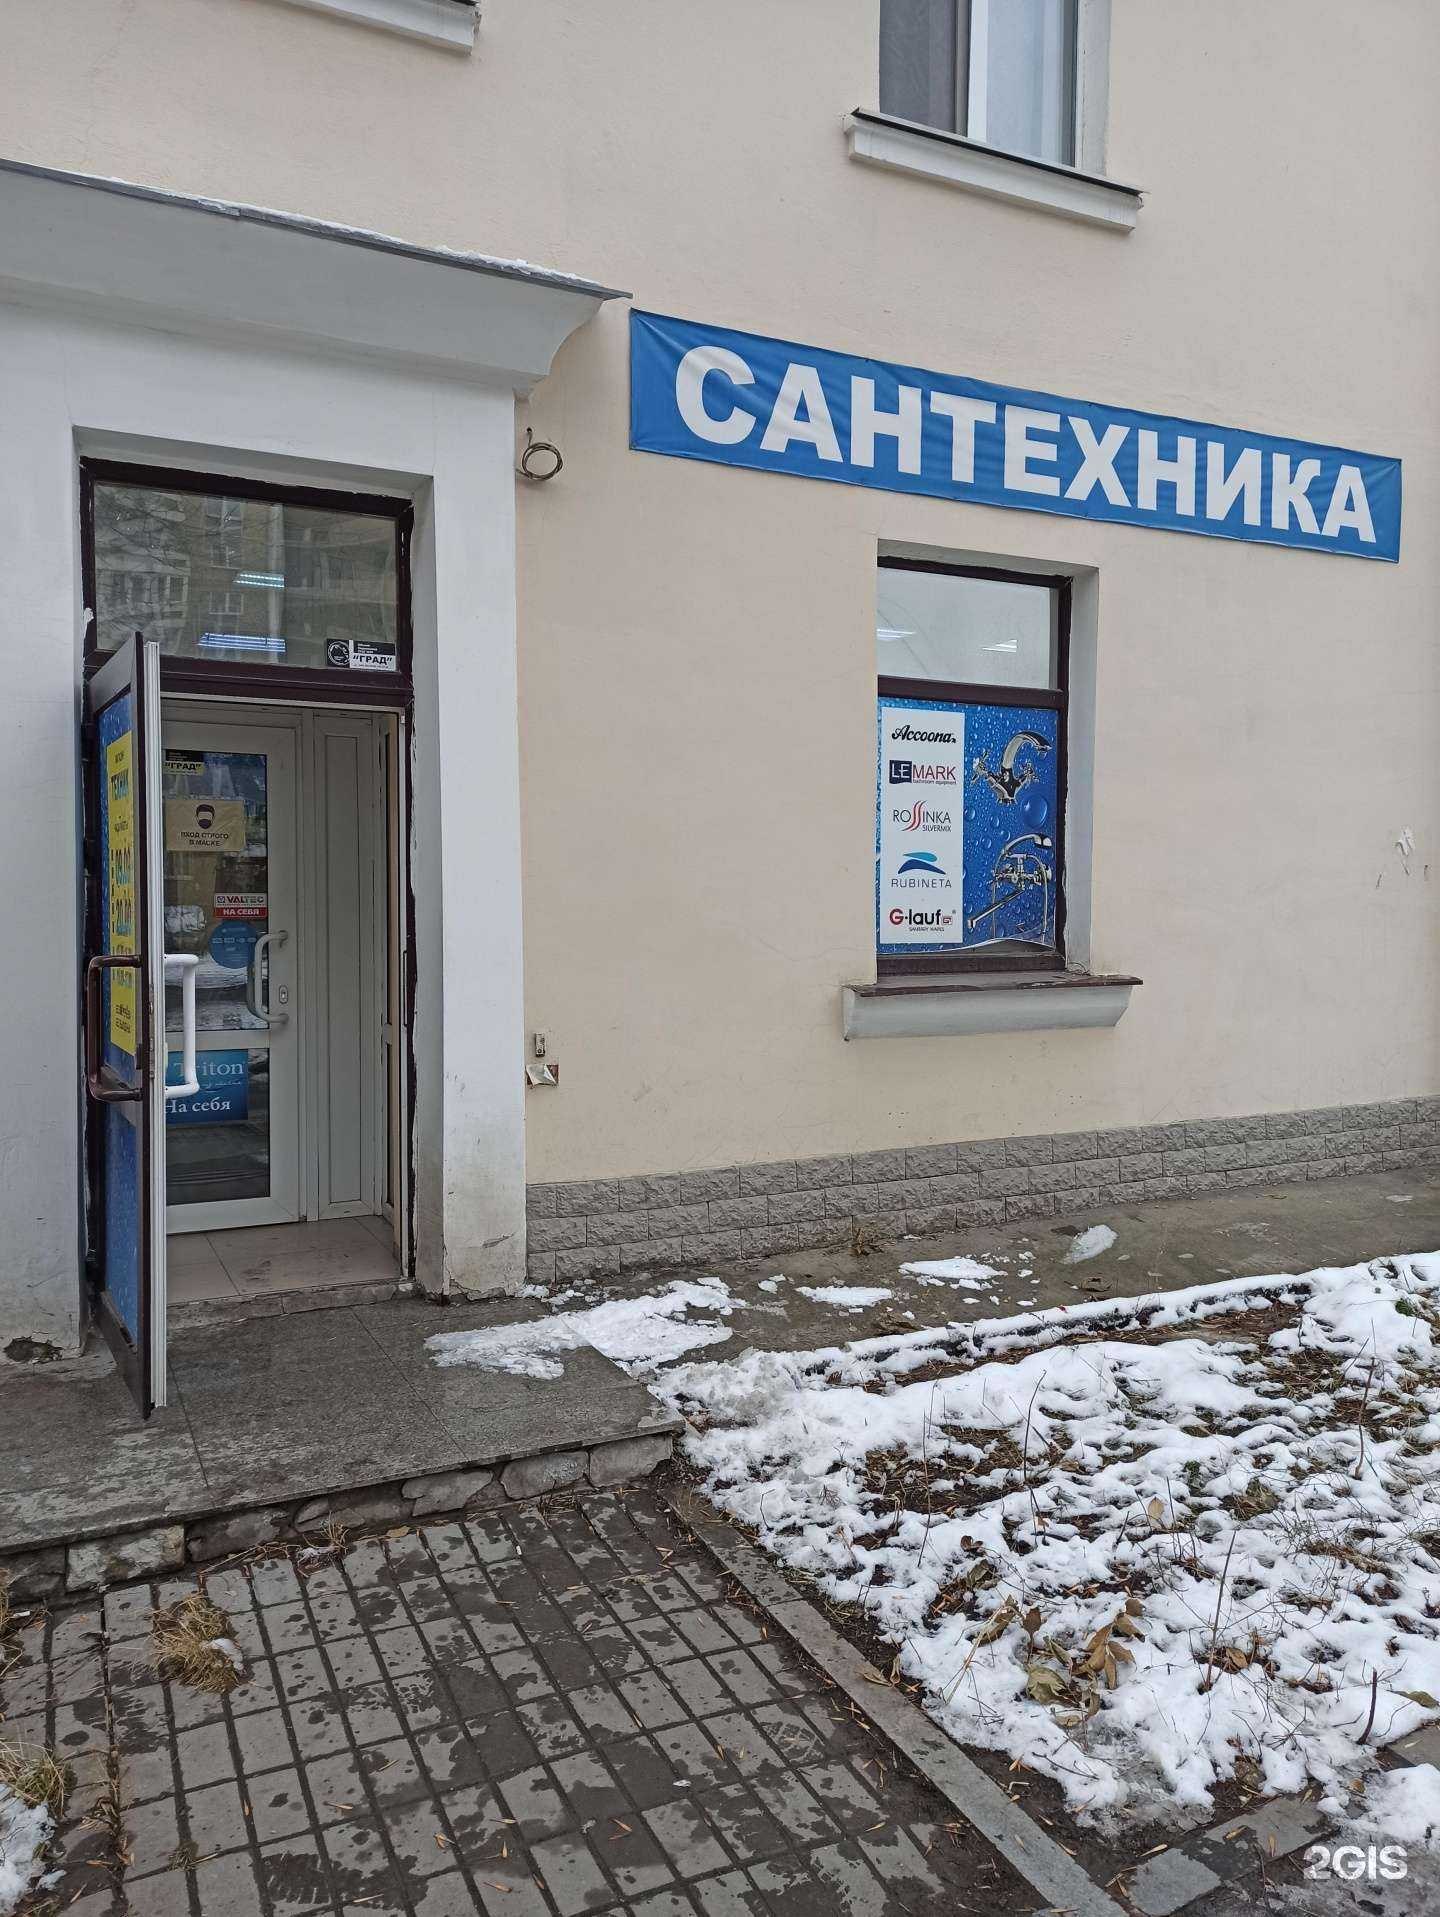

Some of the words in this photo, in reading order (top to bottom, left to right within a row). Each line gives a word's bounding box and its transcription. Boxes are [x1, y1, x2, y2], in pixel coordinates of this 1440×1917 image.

[675, 344, 1377, 545] САНТЕХНИКА
[891, 763, 957, 781] LEMARK
[180, 831, 200, 839] ВХОД
[891, 878, 952, 888] RUBINETA
[227, 895, 264, 903] VALTEC
[173, 1062, 244, 1076] Titon
[191, 1096, 232, 1112] себя
